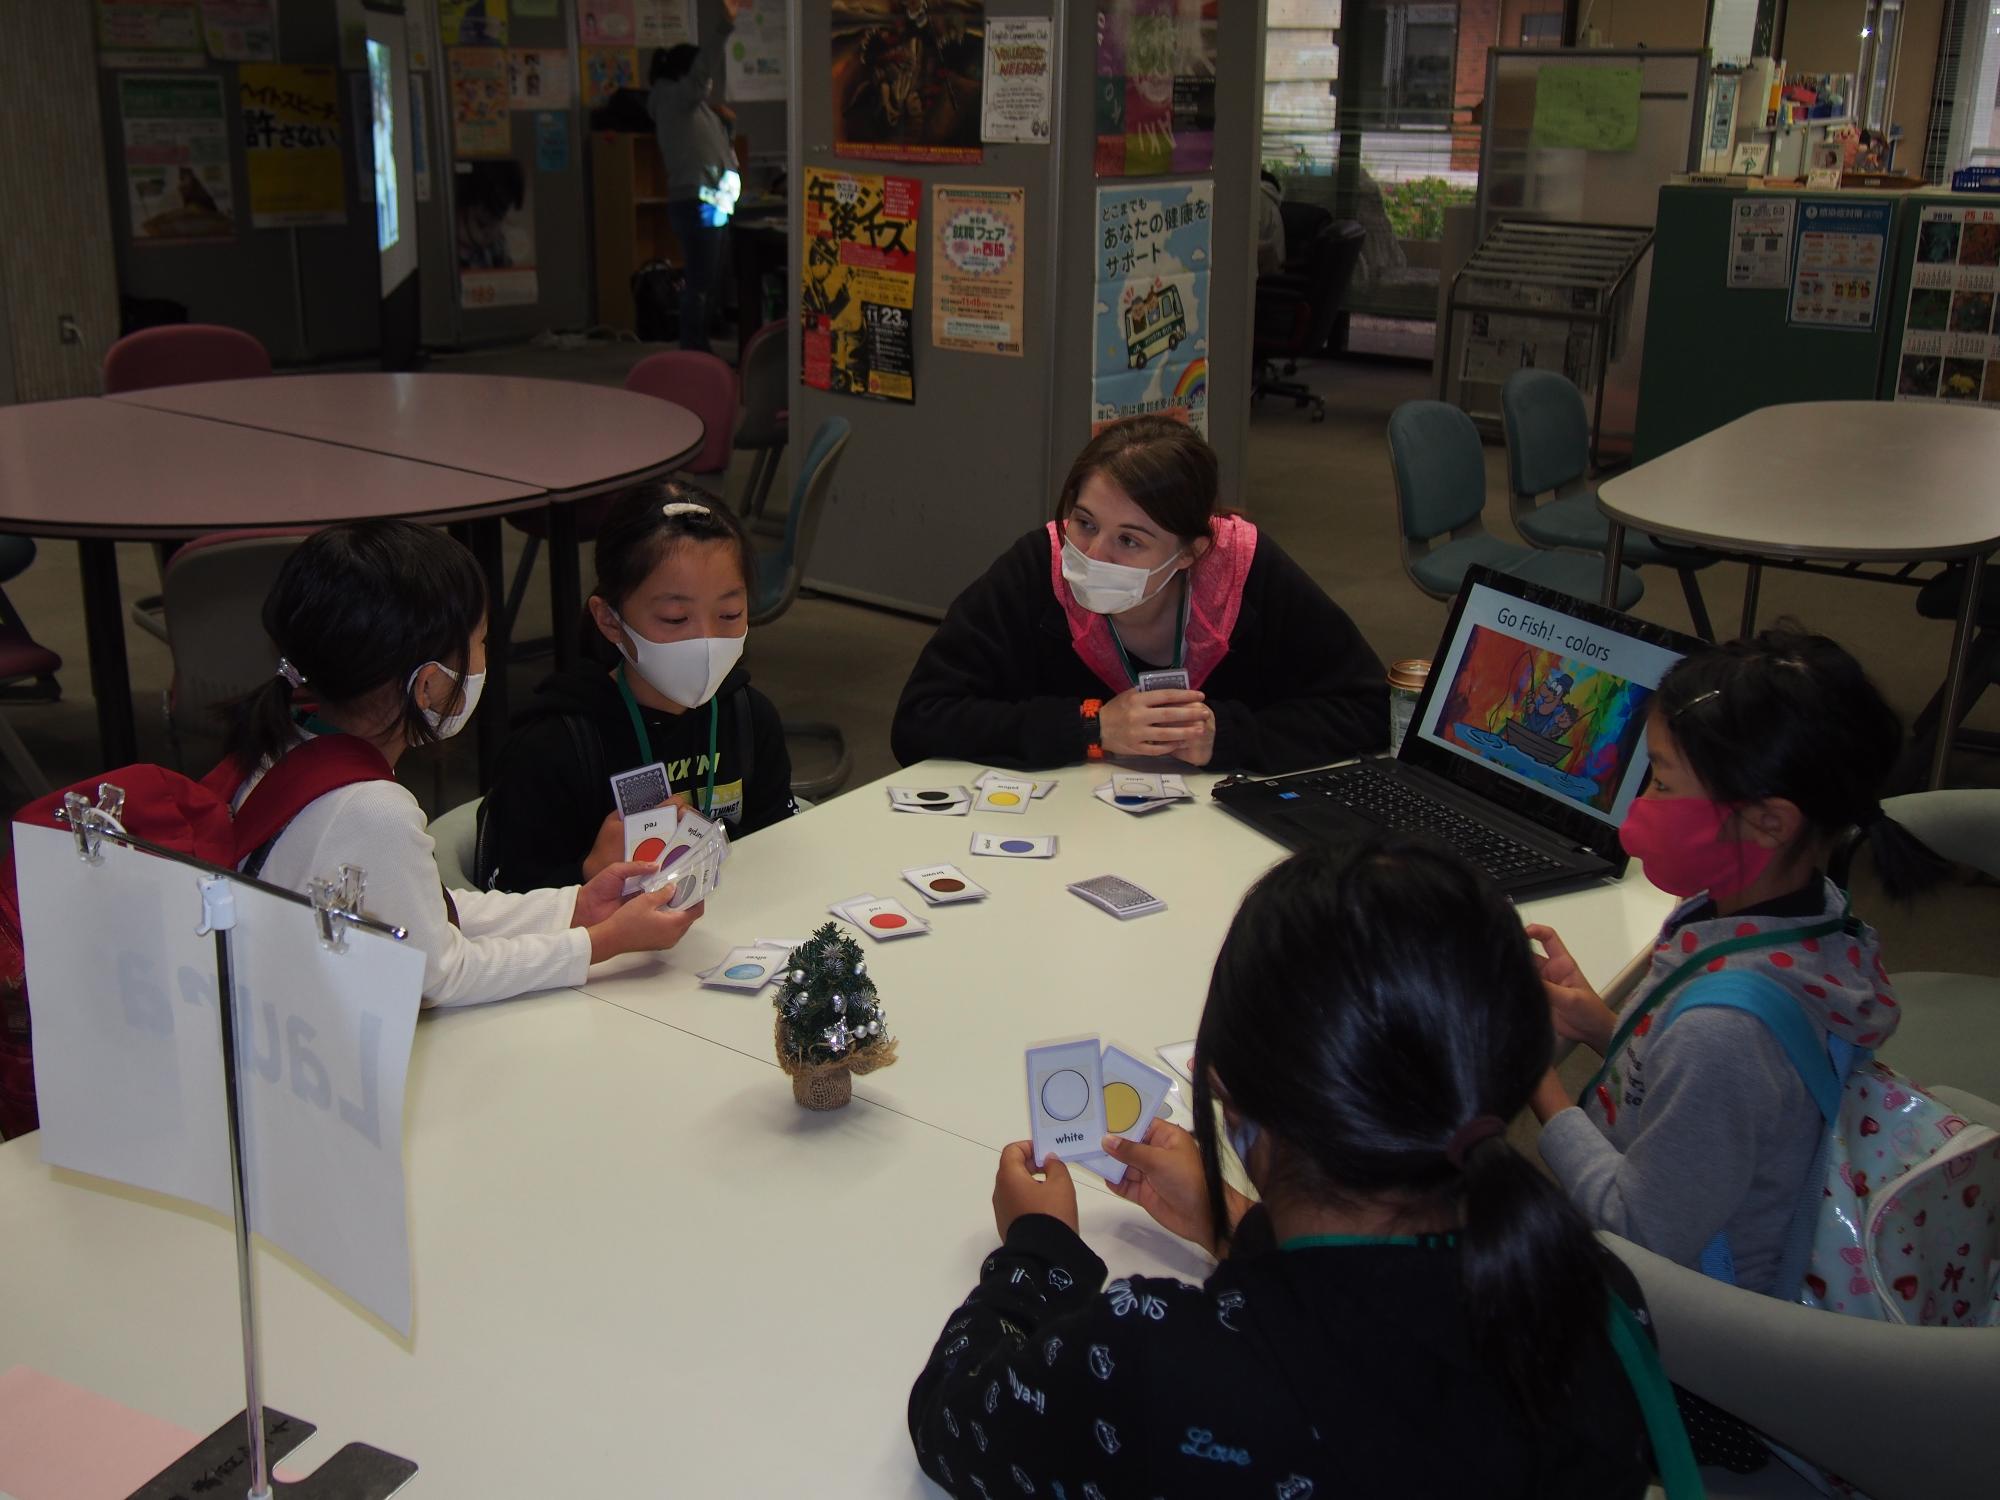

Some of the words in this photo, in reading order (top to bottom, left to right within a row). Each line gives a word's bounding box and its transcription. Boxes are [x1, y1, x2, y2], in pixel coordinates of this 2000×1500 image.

[1102, 197, 1148, 222] どこまでも
[1104, 199, 1207, 250] あなたの健康を
[1106, 242, 1161, 278] サポート
[1497, 607, 1517, 628] Go
[1519, 613, 1555, 641] Fish!
[1565, 633, 1611, 662] colors
[644, 821, 657, 831] red
[1055, 1132, 1084, 1145] white
